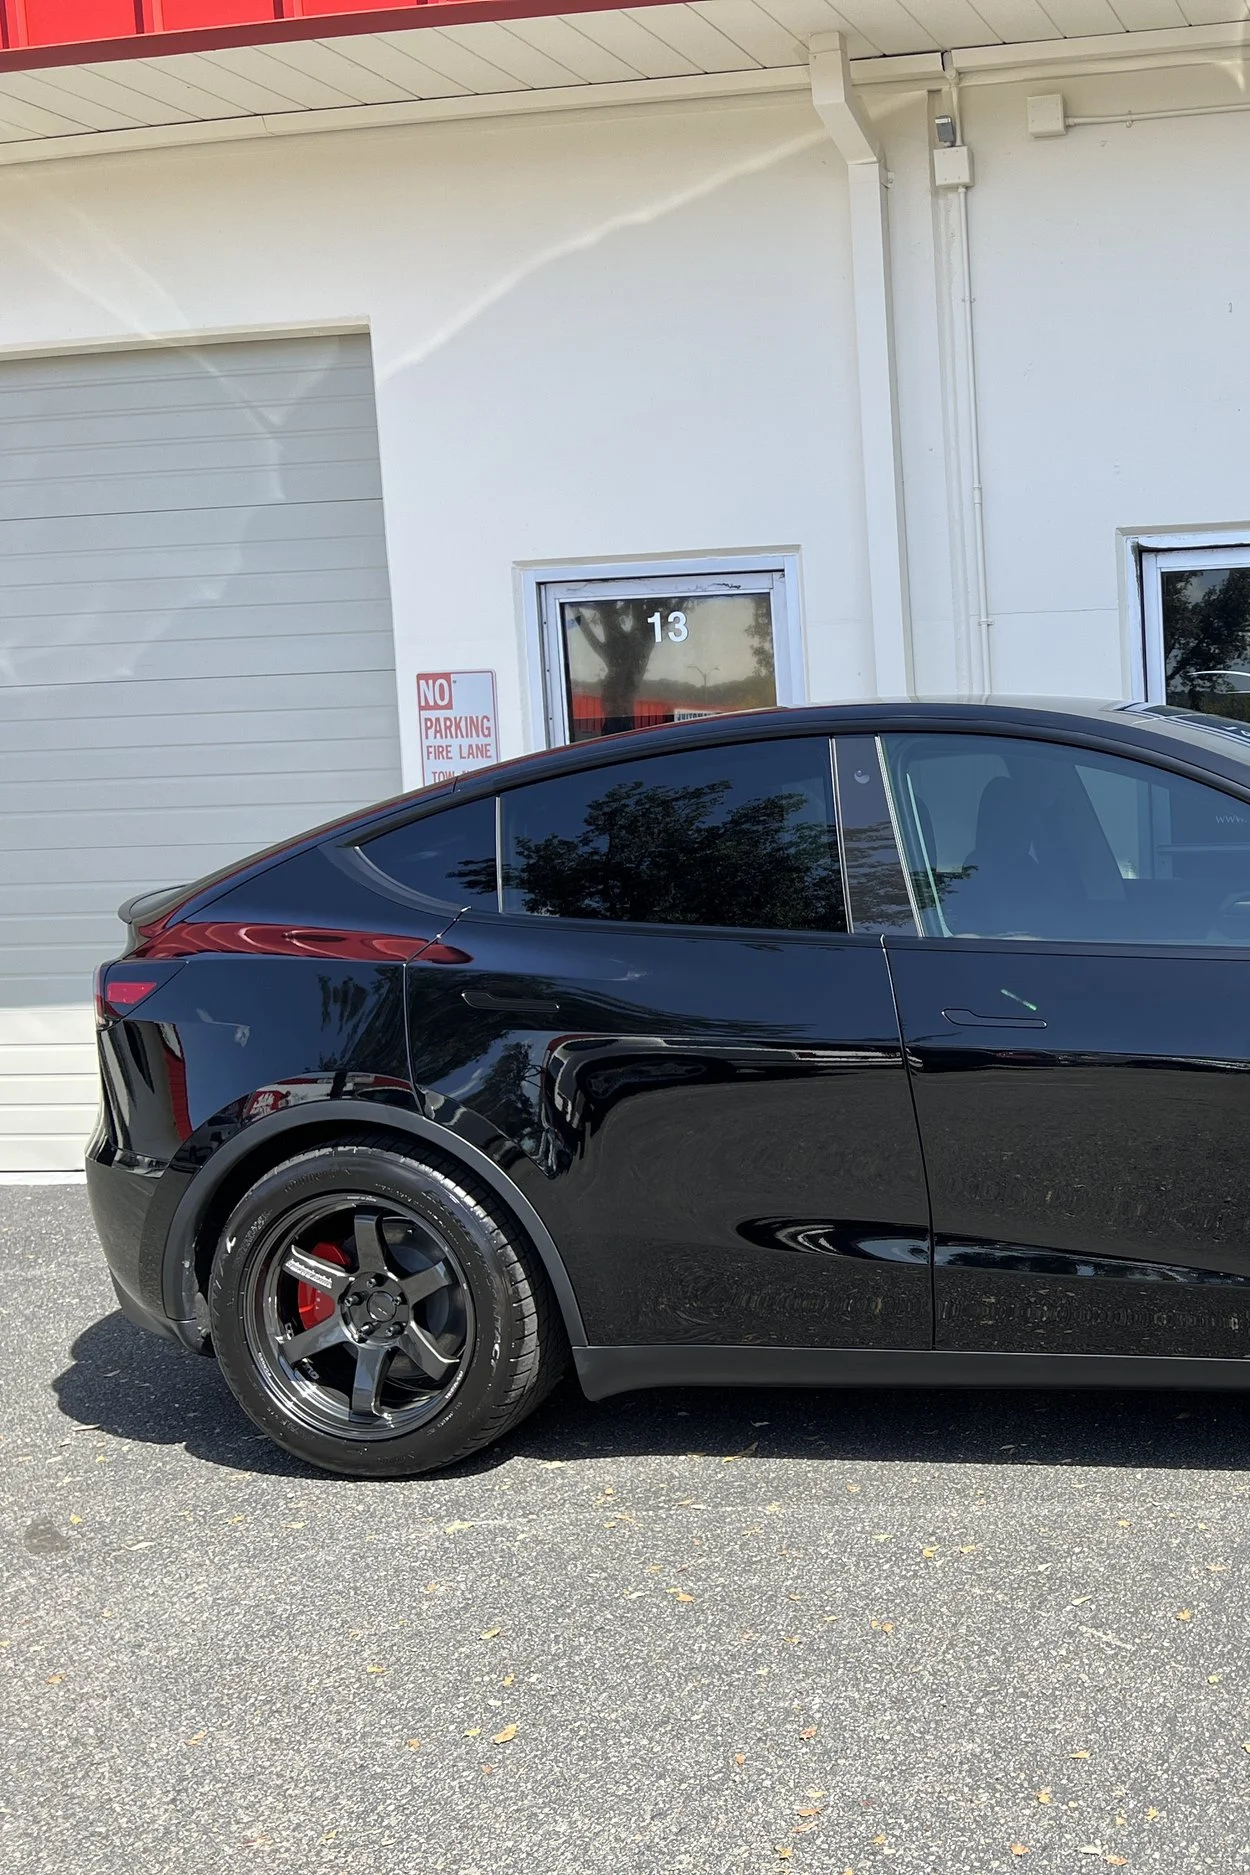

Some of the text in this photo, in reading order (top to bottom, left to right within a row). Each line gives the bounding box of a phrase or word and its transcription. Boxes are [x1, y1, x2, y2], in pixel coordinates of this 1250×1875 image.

[647, 610, 688, 643] 13
[420, 678, 450, 706] NO
[424, 715, 492, 740] PARKING
[426, 743, 492, 761] FIRE LANE
